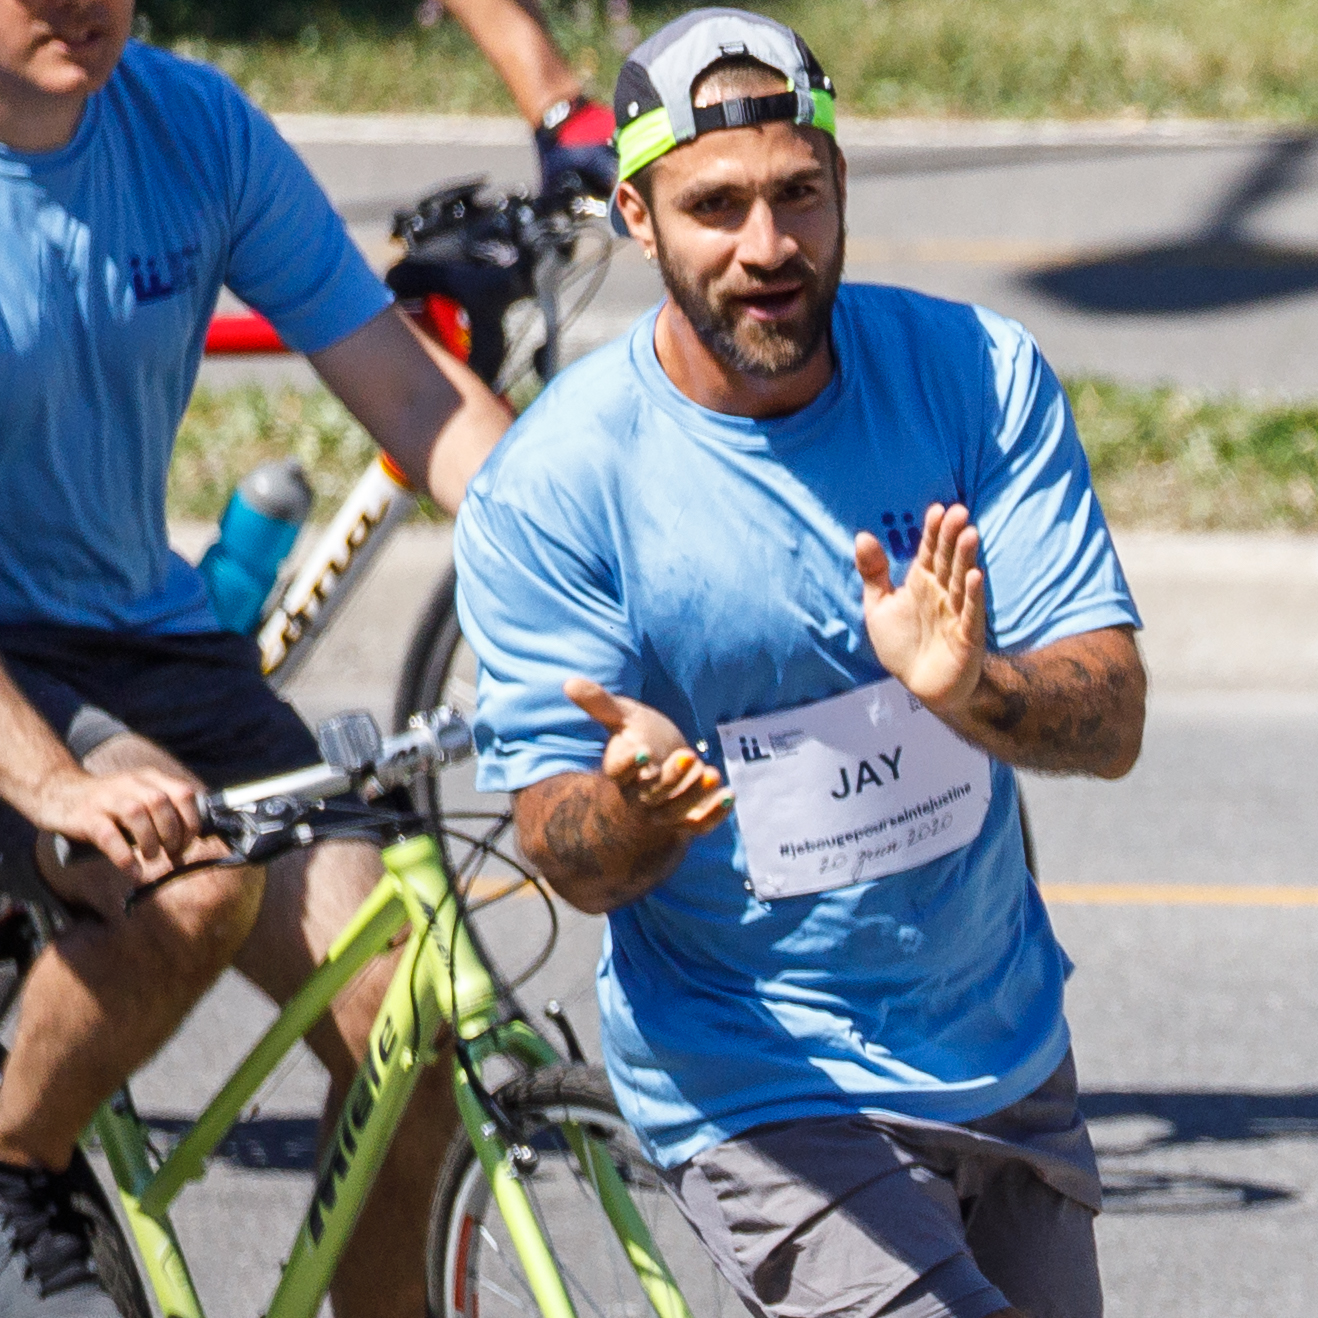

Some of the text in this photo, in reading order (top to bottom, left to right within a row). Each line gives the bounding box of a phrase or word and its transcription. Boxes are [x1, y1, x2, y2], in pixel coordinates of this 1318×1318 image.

[831, 746, 902, 799] JAY
[819, 852, 848, 875] 20
[907, 811, 953, 847] 2020
